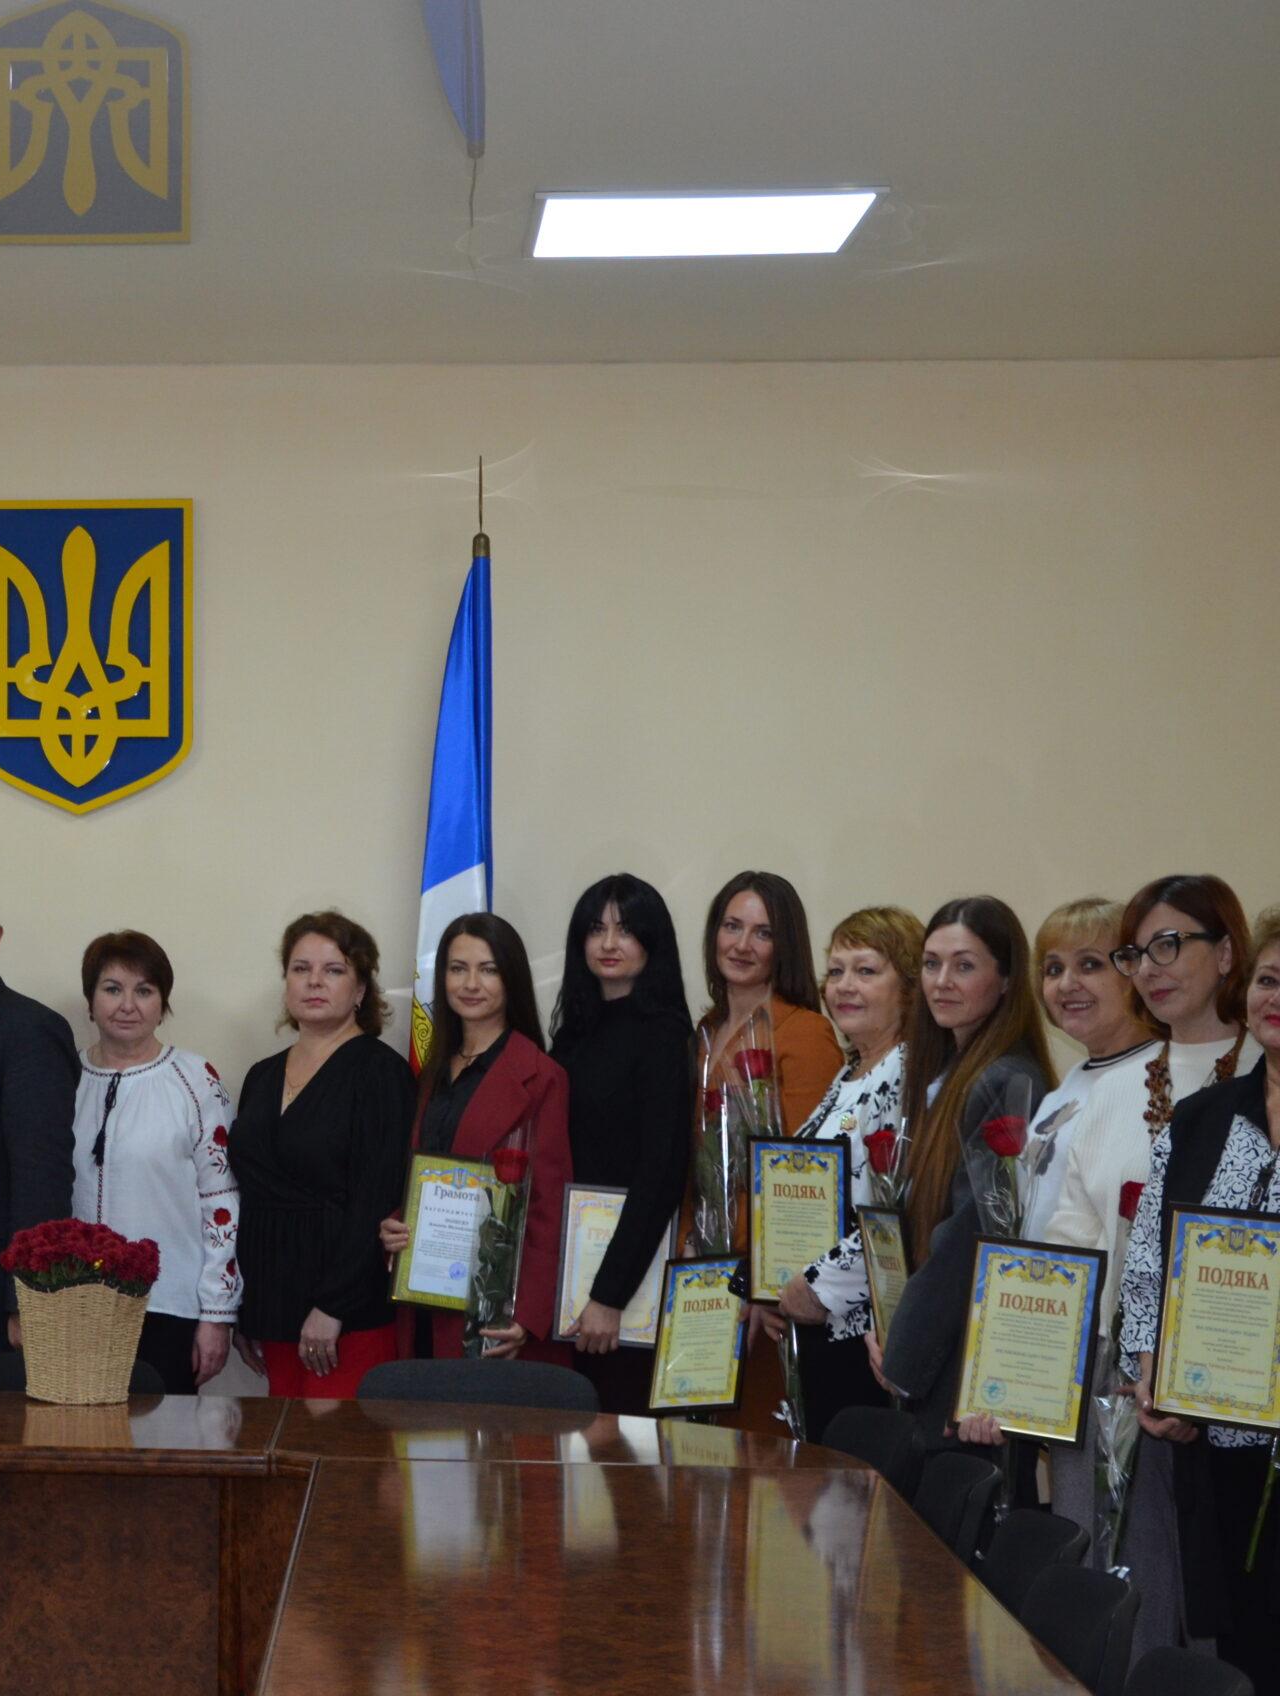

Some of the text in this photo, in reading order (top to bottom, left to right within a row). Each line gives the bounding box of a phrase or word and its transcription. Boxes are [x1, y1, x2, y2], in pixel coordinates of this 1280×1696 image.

[433, 1185, 481, 1202] Грамота
[773, 1183, 826, 1200] ПОДЯКА
[1198, 1265, 1270, 1291] ПОДЯКА
[683, 1298, 731, 1314] ПОДЯКА
[999, 1292, 1069, 1317] ПОДЯКА
